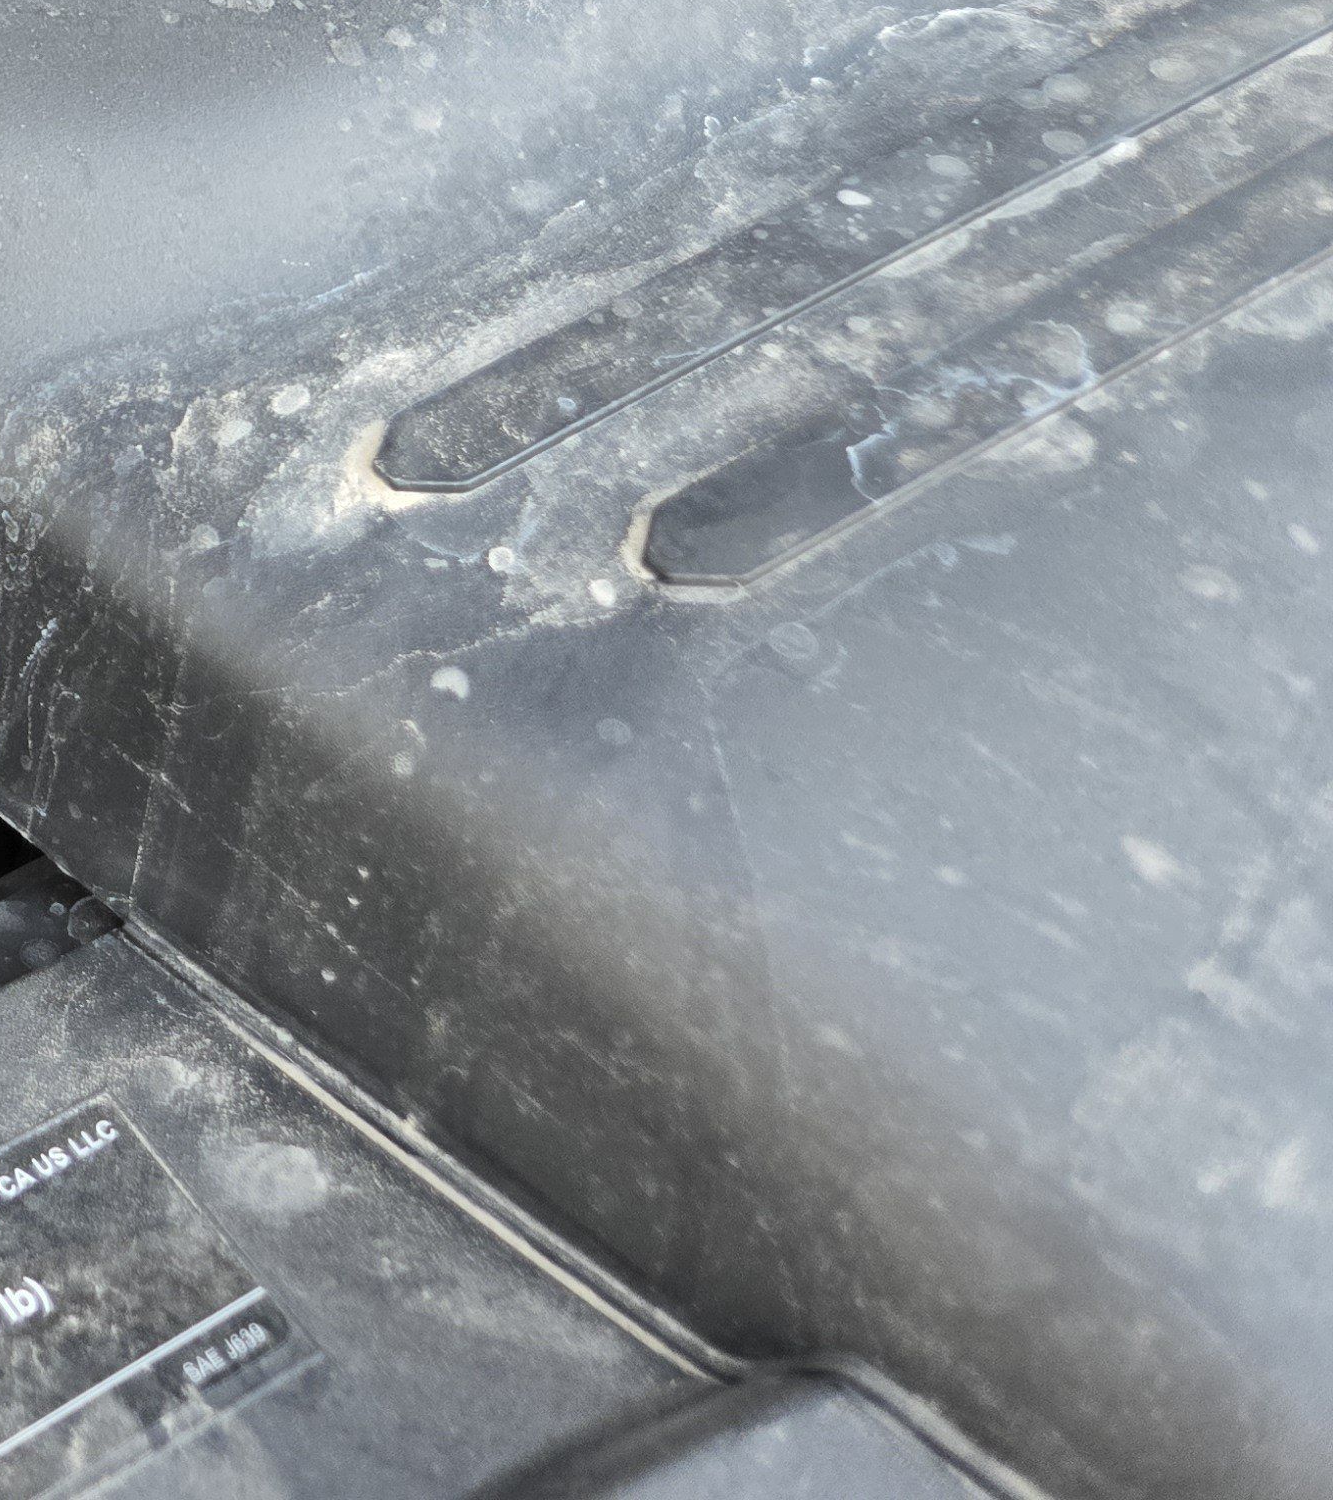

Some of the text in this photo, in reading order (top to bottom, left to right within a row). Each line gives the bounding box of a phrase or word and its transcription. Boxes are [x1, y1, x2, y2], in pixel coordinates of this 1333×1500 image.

[31, 1146, 71, 1179] US
[68, 1119, 119, 1159] LLC
[182, 1346, 226, 1384] SAE
